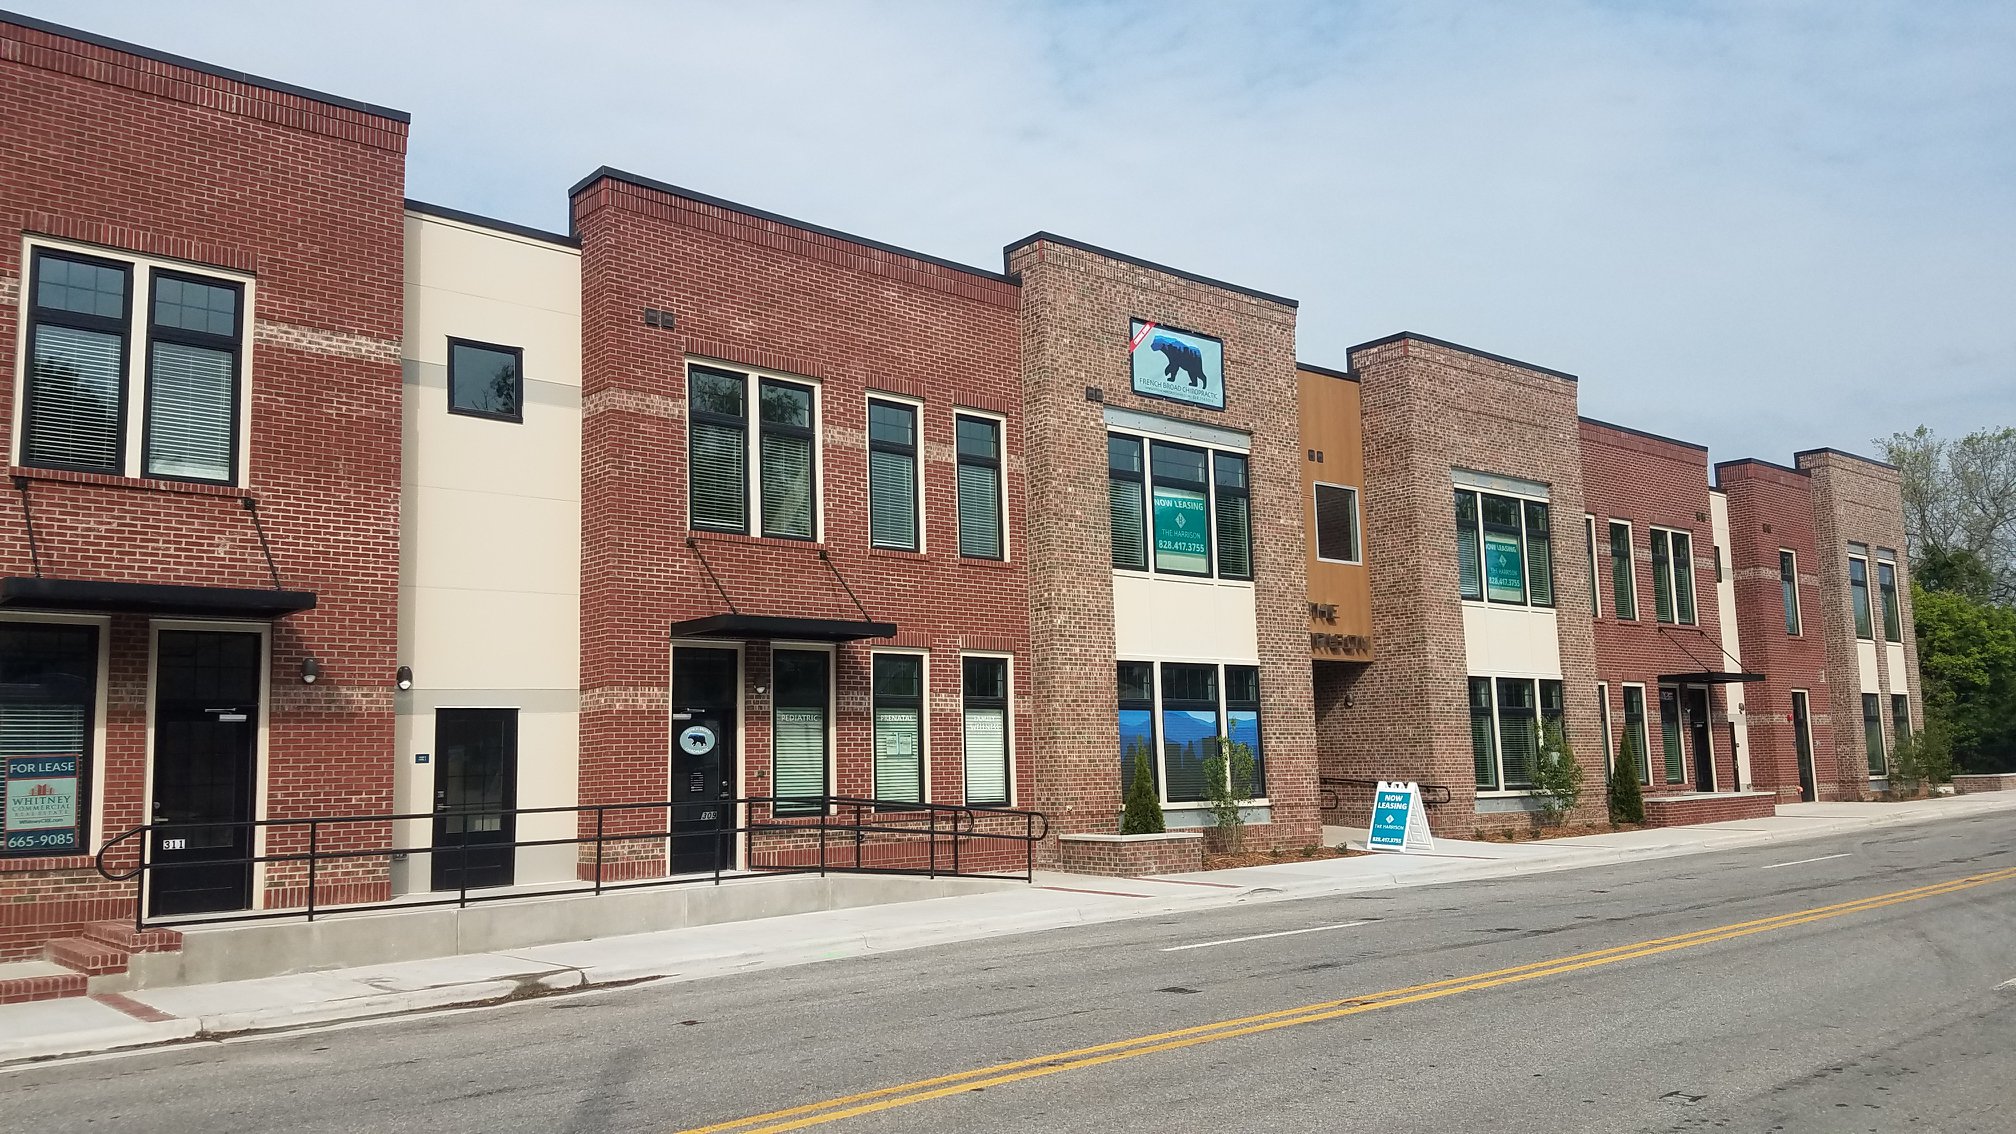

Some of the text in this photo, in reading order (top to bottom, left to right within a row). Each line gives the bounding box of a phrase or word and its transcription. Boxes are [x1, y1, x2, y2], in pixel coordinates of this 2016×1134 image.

[1139, 377, 1163, 388] FRENCH
[1163, 382, 1182, 392] BROAD
[1182, 386, 1218, 400] CHIROPRACTIC
[1154, 498, 1204, 511] NOW LEASING
[1161, 528, 1201, 540] THE HARRISON
[1158, 540, 1205, 553] 828.417.3755
[1497, 544, 1517, 553] LEASING
[781, 714, 819, 722] PEDIATRIC
[880, 714, 914, 722] PRENATAL
[9, 761, 76, 774] FOR LEASE
[12, 795, 71, 806] WHITNEY
[1384, 794, 1404, 802] NOW
[12, 804, 71, 812] COMMERCIAL
[1377, 802, 1408, 810] LEASING
[702, 811, 718, 820] 309
[8, 833, 74, 848] 665-9085
[164, 840, 184, 849] 311
